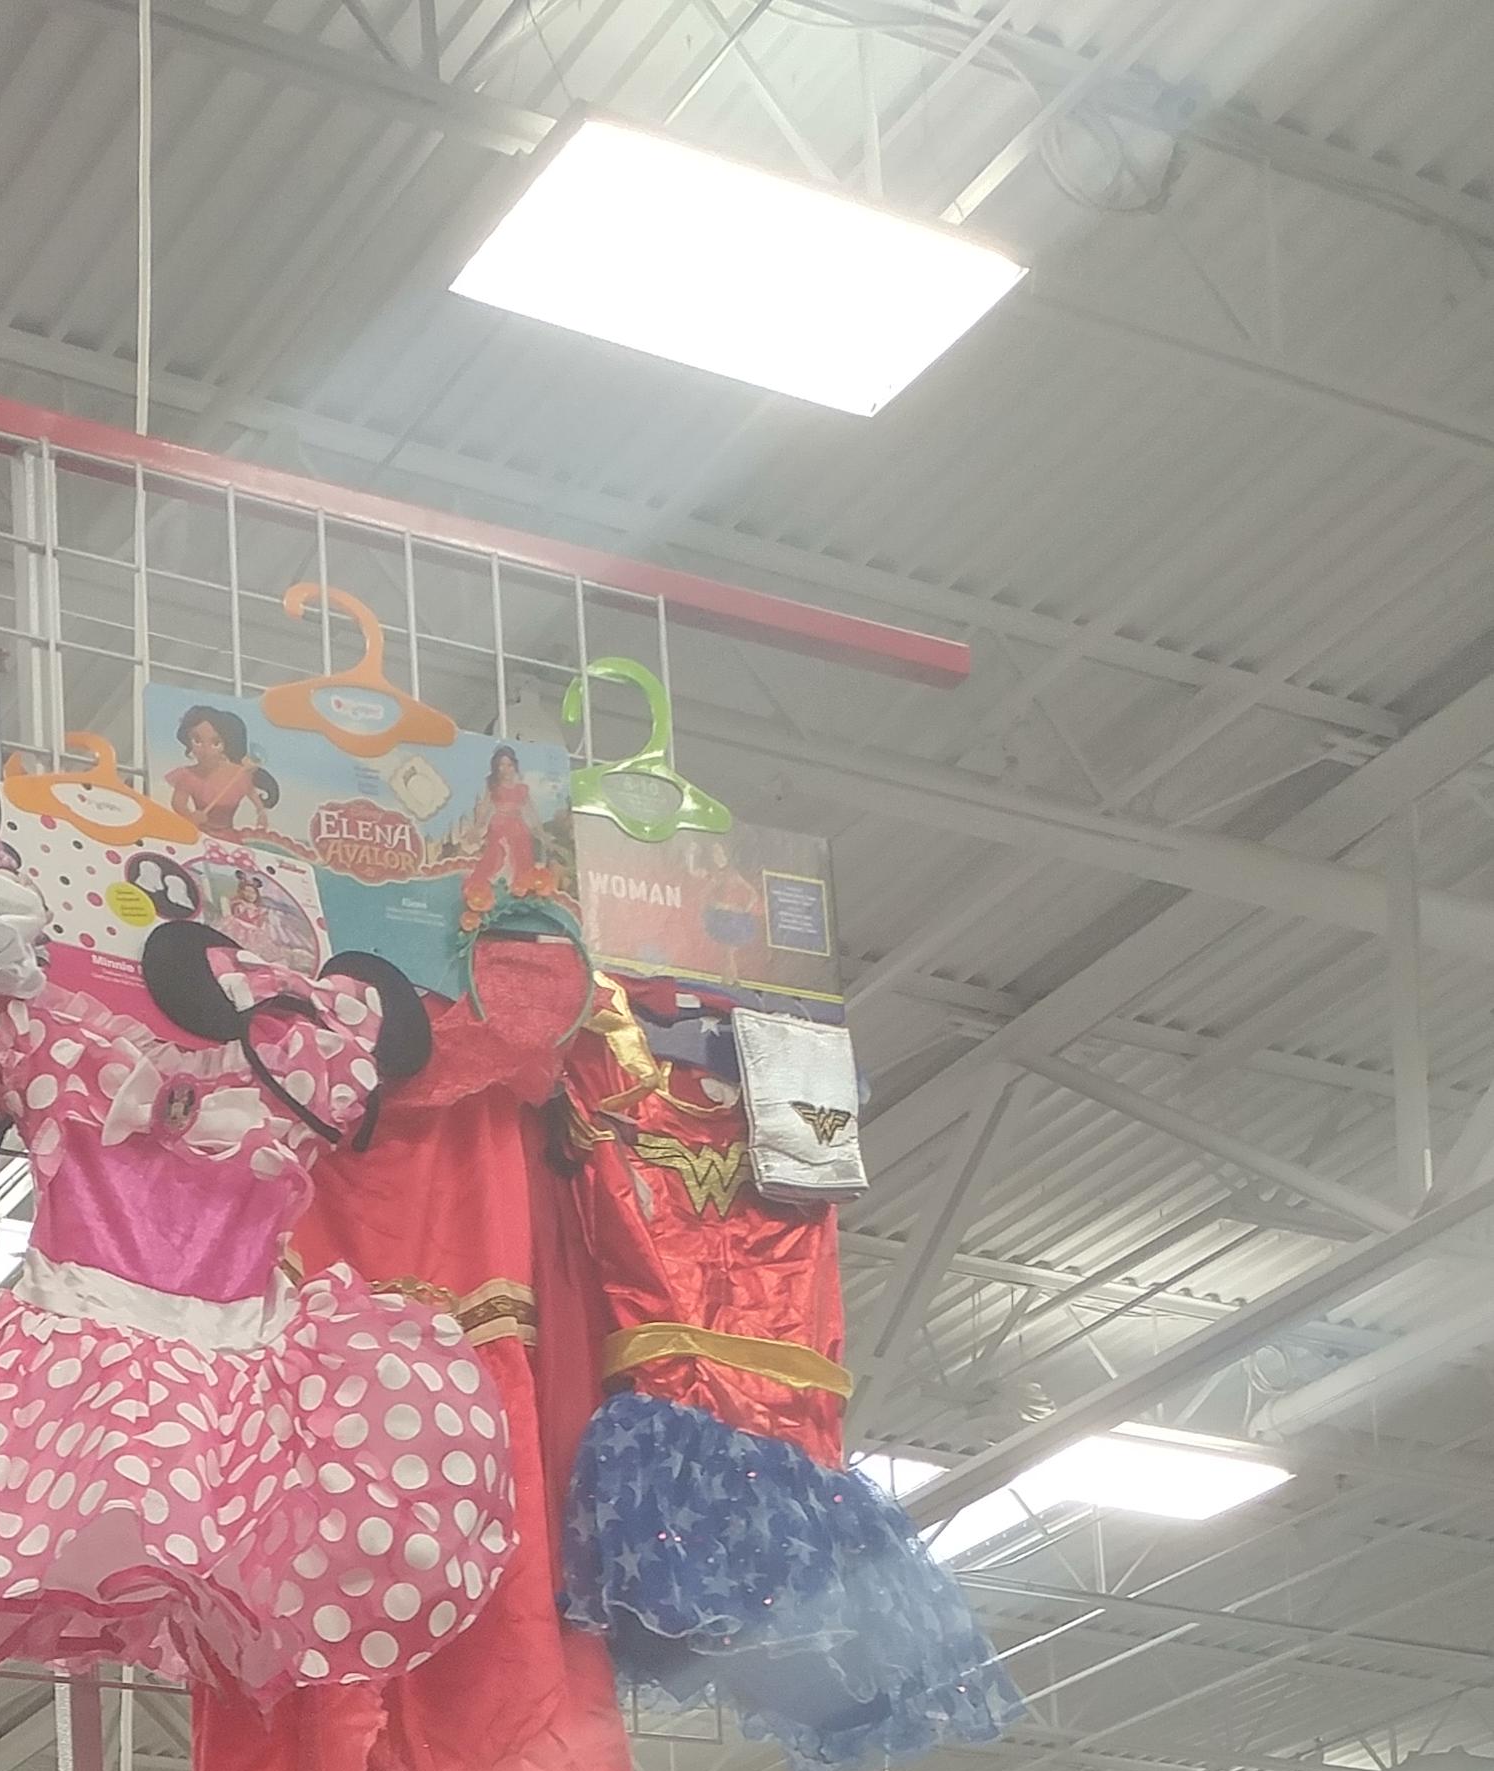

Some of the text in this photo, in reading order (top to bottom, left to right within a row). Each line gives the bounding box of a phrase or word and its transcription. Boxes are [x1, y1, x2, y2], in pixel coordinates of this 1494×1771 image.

[315, 809, 415, 853] ELENA
[326, 837, 420, 873] AVALOR
[588, 871, 682, 908] WOMAN
